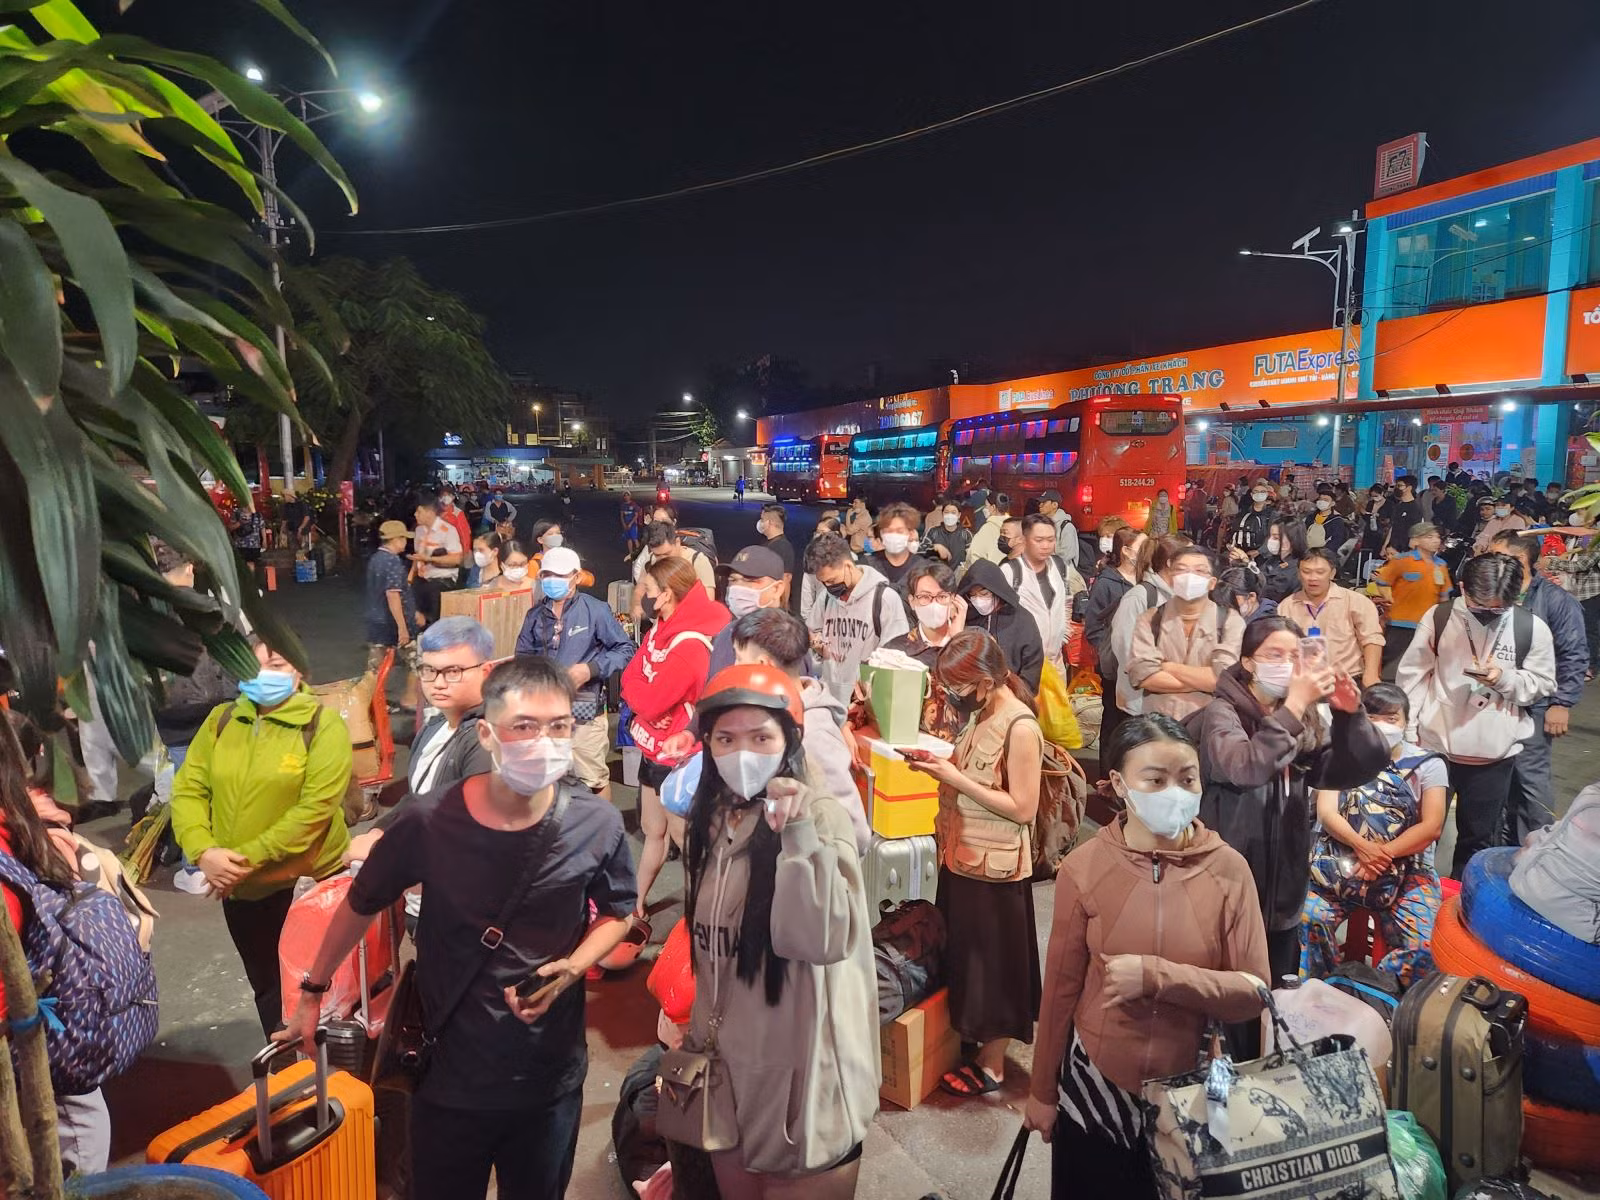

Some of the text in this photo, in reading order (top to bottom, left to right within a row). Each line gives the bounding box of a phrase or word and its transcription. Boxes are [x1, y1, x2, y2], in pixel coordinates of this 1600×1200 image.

[1148, 369, 1225, 395] TRANG
[1241, 1143, 1361, 1190] CHRISTIAN DIOR
